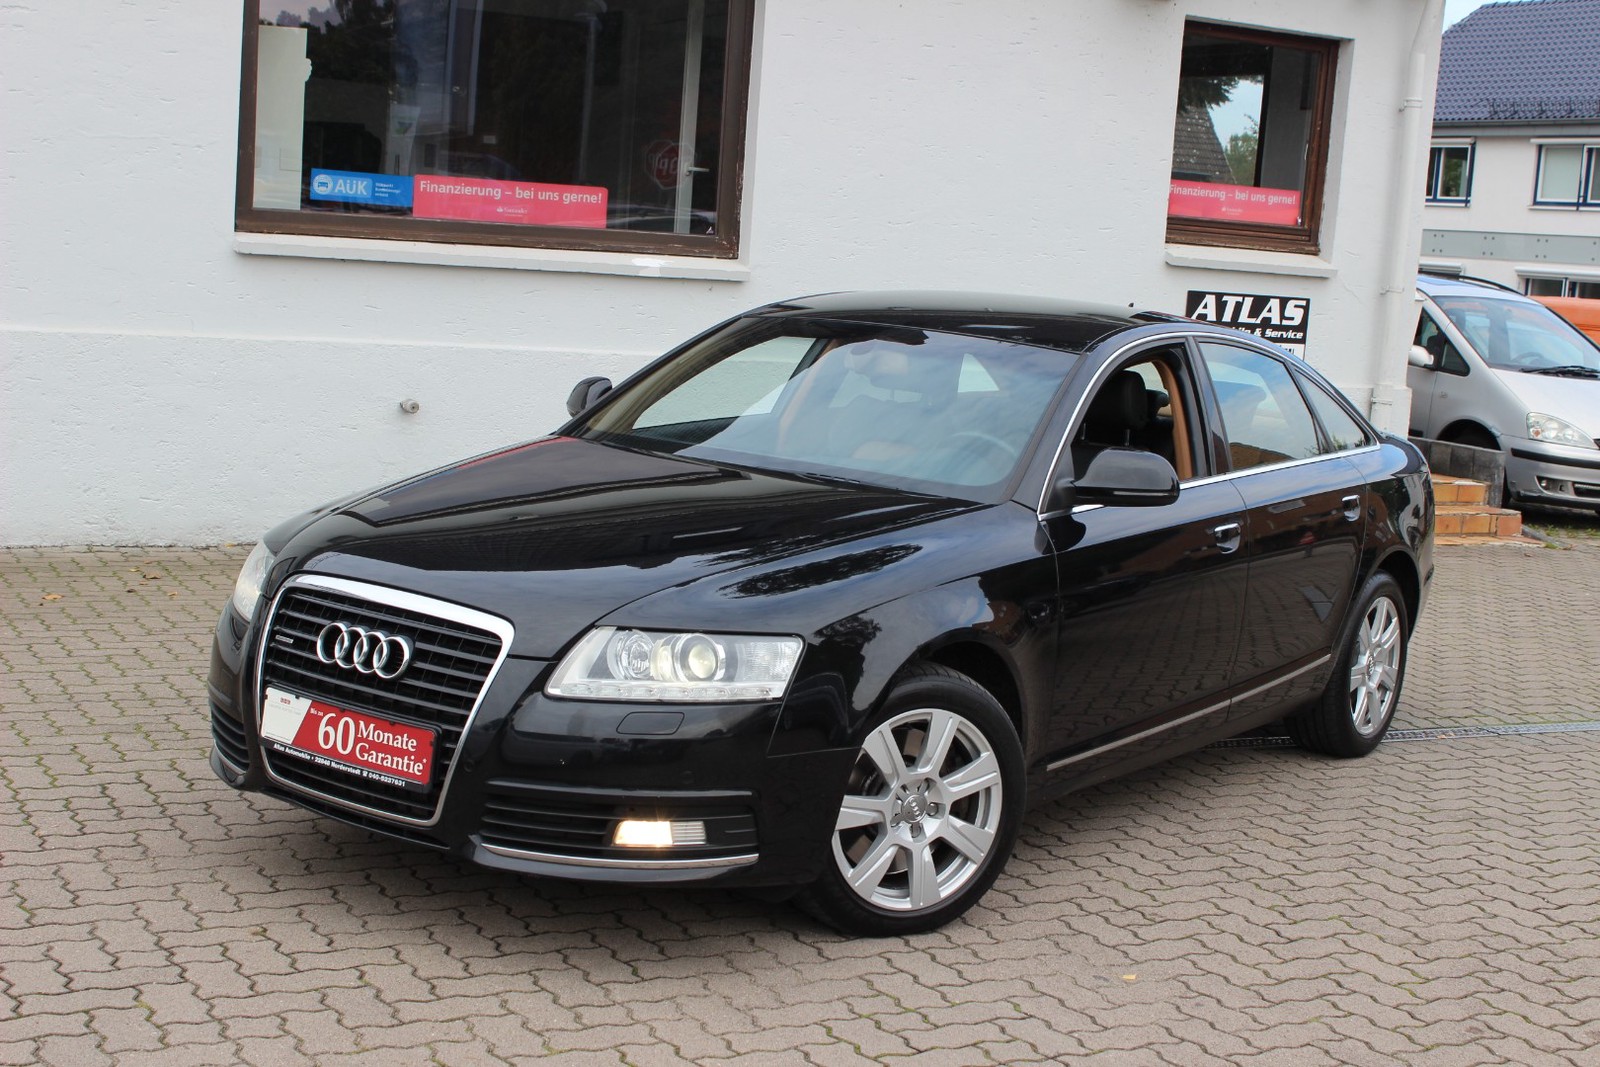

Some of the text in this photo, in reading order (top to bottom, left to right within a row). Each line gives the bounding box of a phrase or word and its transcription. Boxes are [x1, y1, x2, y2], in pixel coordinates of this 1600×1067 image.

[420, 180, 502, 200] Finanzierung
[515, 187, 534, 200] bei
[538, 191, 559, 201] uns
[562, 193, 602, 205] gerne!
[1169, 184, 1226, 200] Finanzierung
[1235, 190, 1248, 200] bei
[1251, 192, 1266, 202] uns
[1267, 194, 1296, 205] gerne!
[1190, 294, 1307, 326] ATLAS
[1265, 328, 1304, 339] Service
[318, 712, 417, 755] 60 Monate
